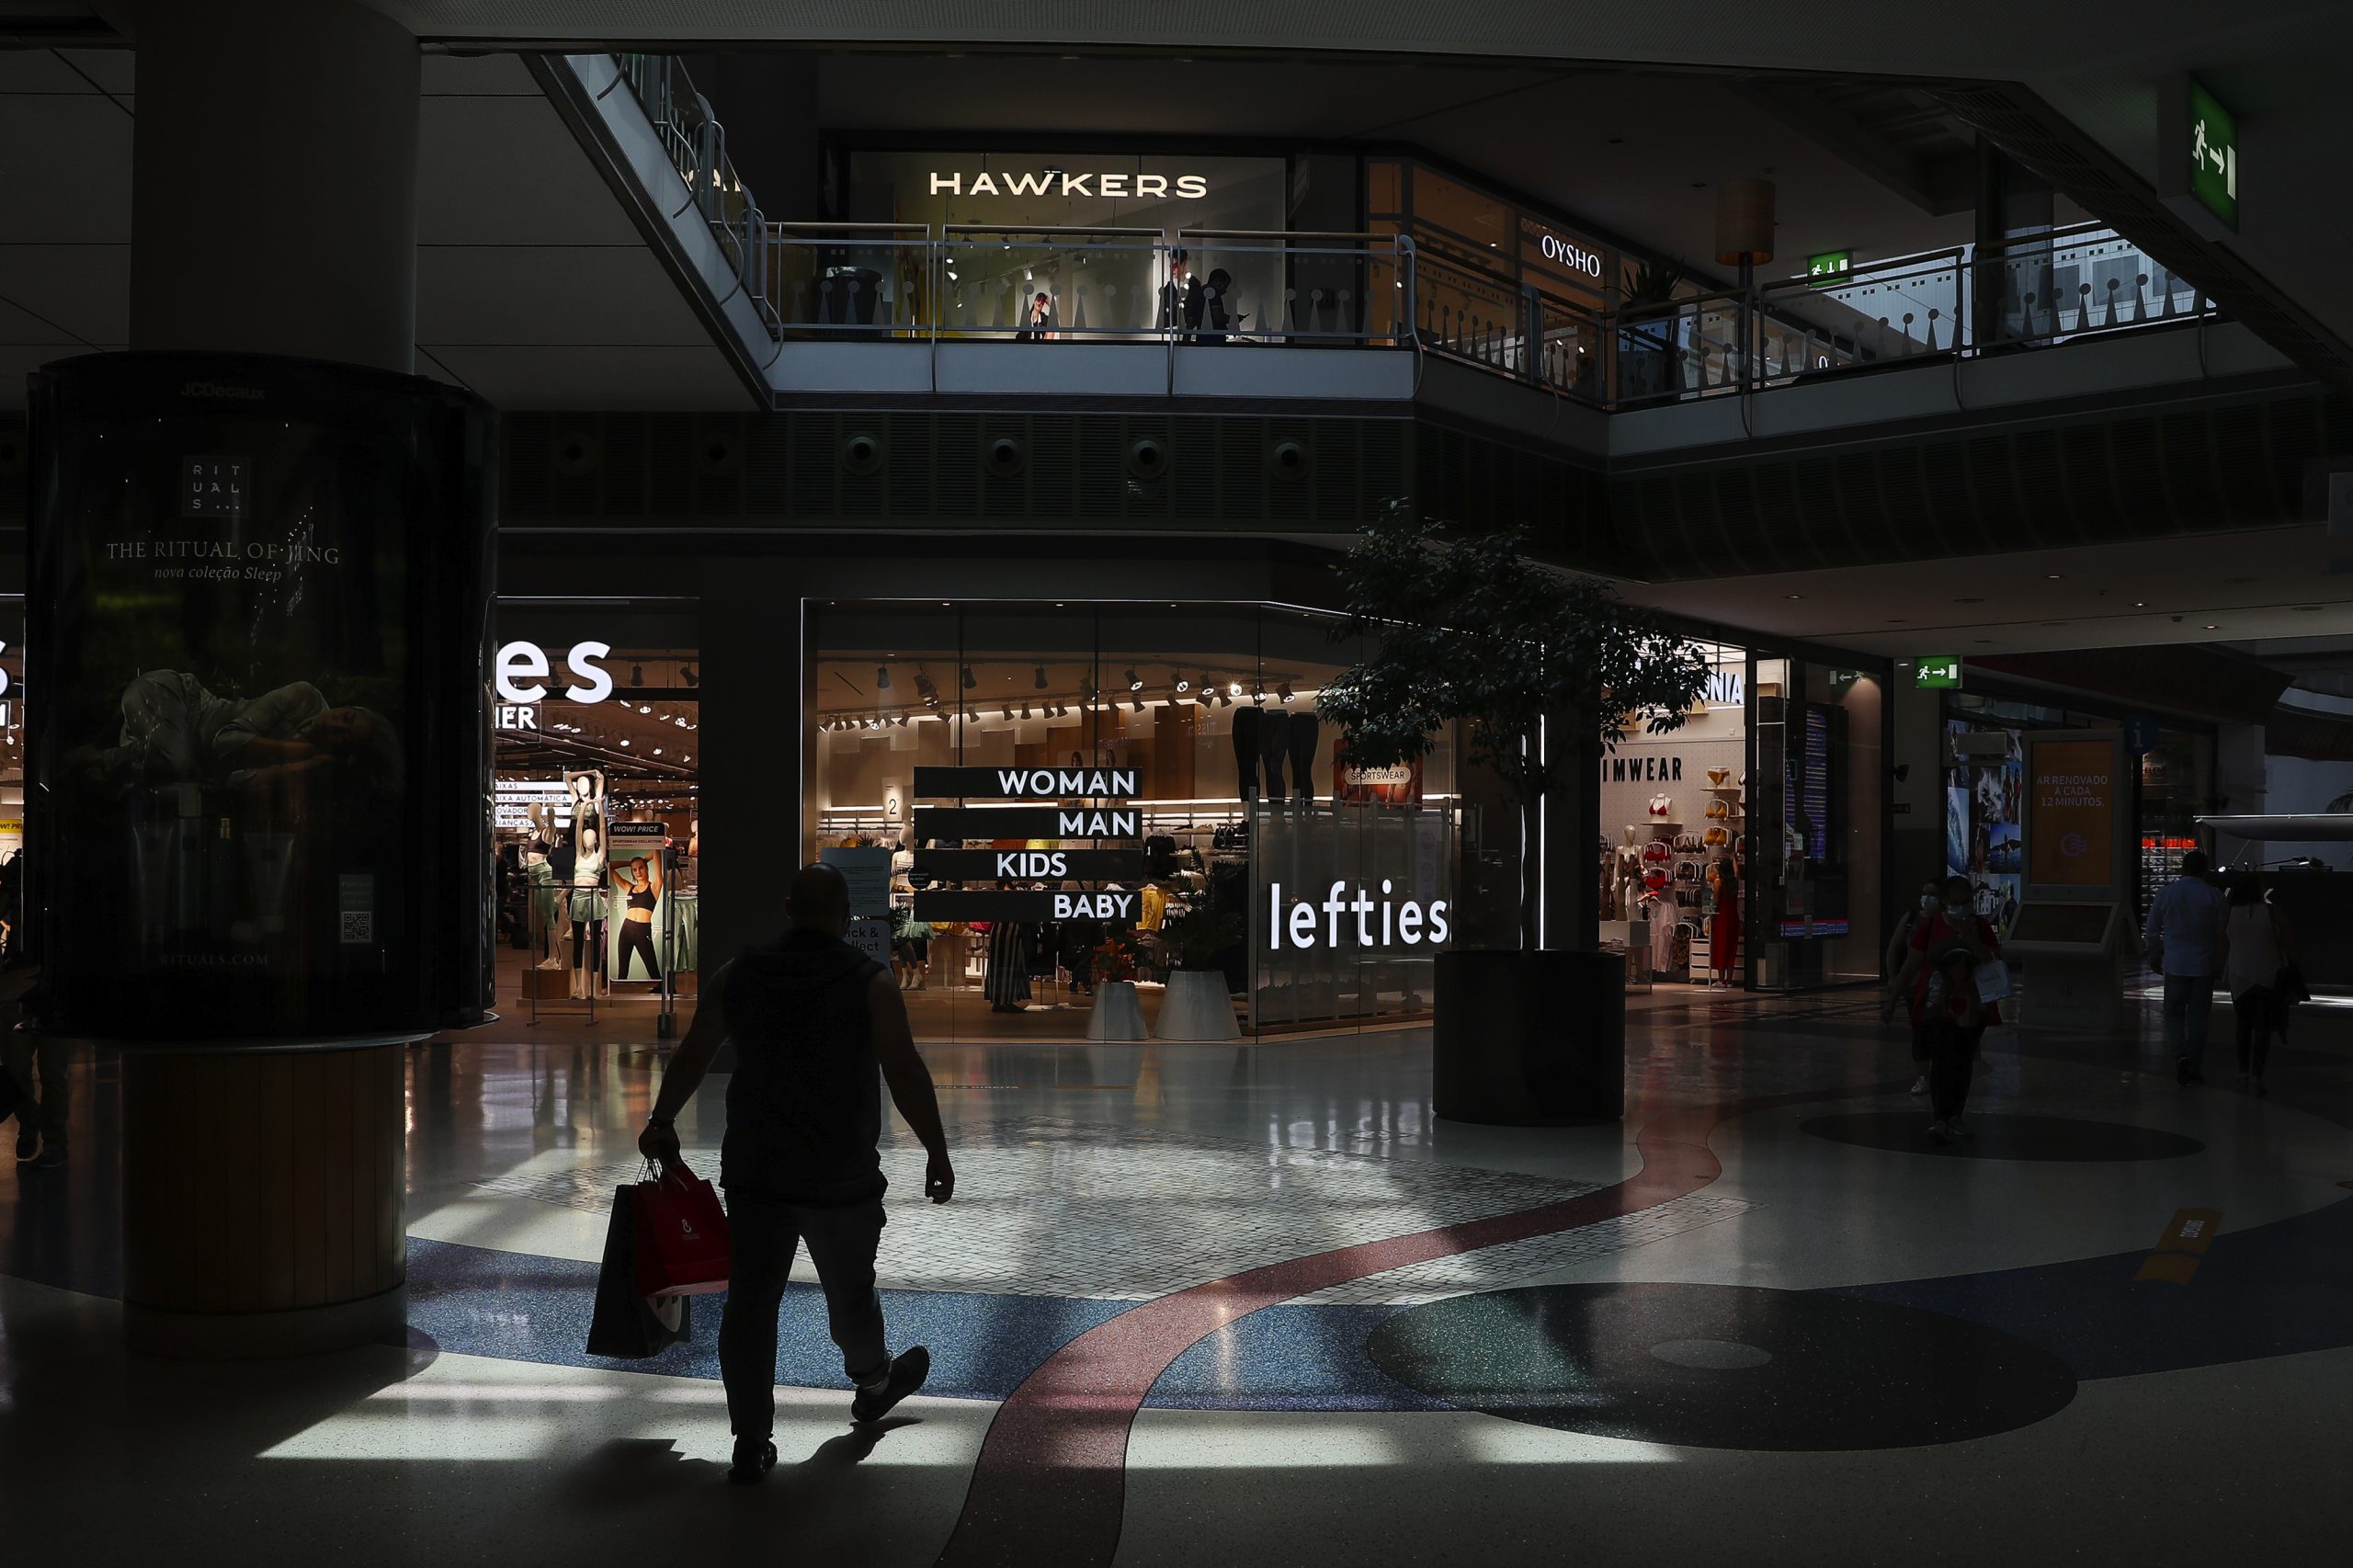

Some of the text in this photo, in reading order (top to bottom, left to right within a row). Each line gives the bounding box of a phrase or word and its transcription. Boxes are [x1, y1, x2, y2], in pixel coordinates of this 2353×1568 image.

[929, 171, 1208, 199] HAWKERS
[1541, 234, 1601, 278] OYSHO
[179, 381, 266, 400] JCDecaux
[107, 540, 340, 564] THE RITUAL OF JING
[154, 564, 283, 584] nova coleção Sleep
[997, 770, 1136, 796] WOMAN
[1350, 770, 1406, 780] SPORTSWEAR
[2036, 775, 2109, 785] AR RENOVADO
[2054, 787, 2091, 796] A CADA
[889, 798, 897, 815] 2
[2040, 797, 2105, 807] 12 MINUTOS.
[1059, 811, 1136, 836] MAN
[996, 852, 1068, 878] KIDS
[1053, 893, 1132, 919] BABY
[1269, 878, 1449, 950] lefties
[870, 926, 880, 938] &
[161, 953, 268, 965] RITUALS.COM
